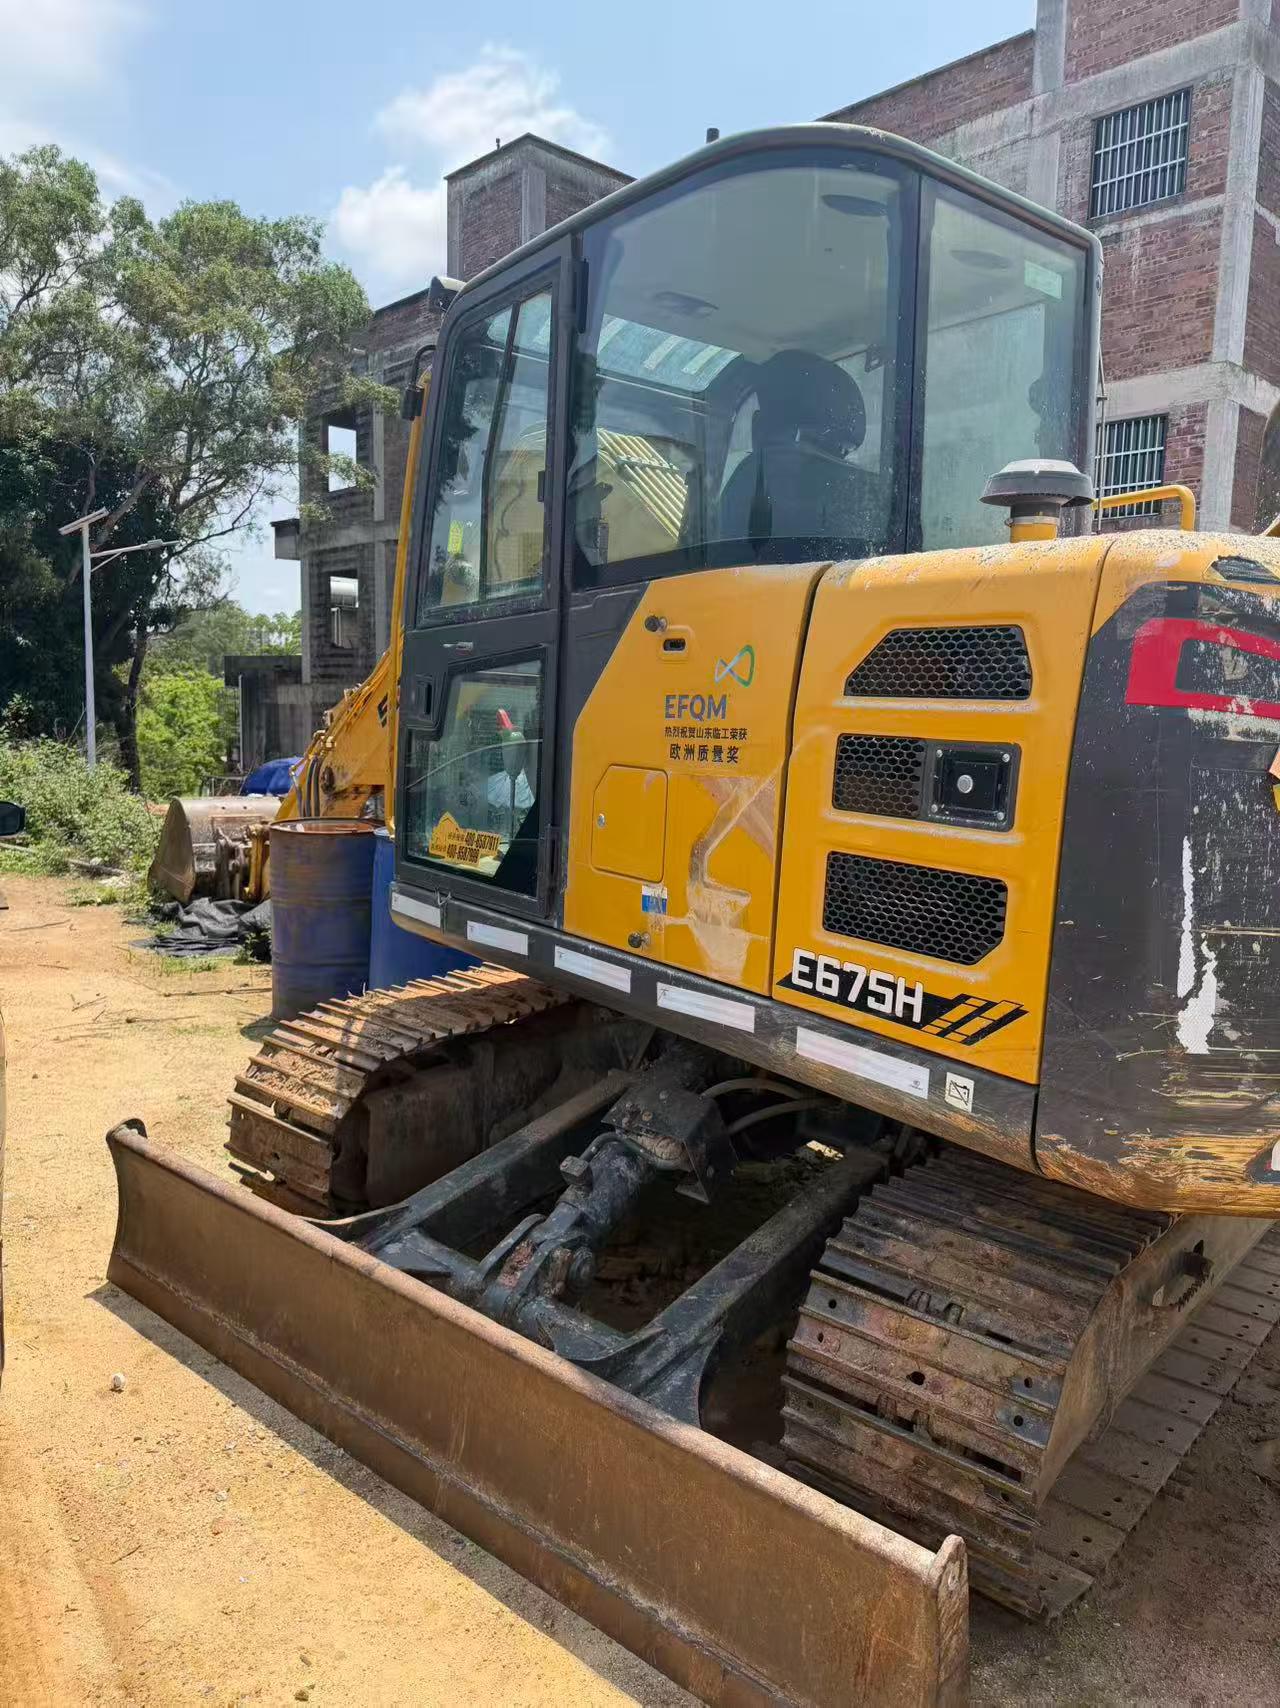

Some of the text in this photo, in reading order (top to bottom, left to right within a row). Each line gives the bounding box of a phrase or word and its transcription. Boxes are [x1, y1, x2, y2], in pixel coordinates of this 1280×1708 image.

[665, 694, 727, 721] EFQM
[664, 726, 748, 740] 热烈祝贺山东临工荣获
[670, 743, 739, 763] 欧洲质量奖
[791, 947, 924, 1023] E675H
